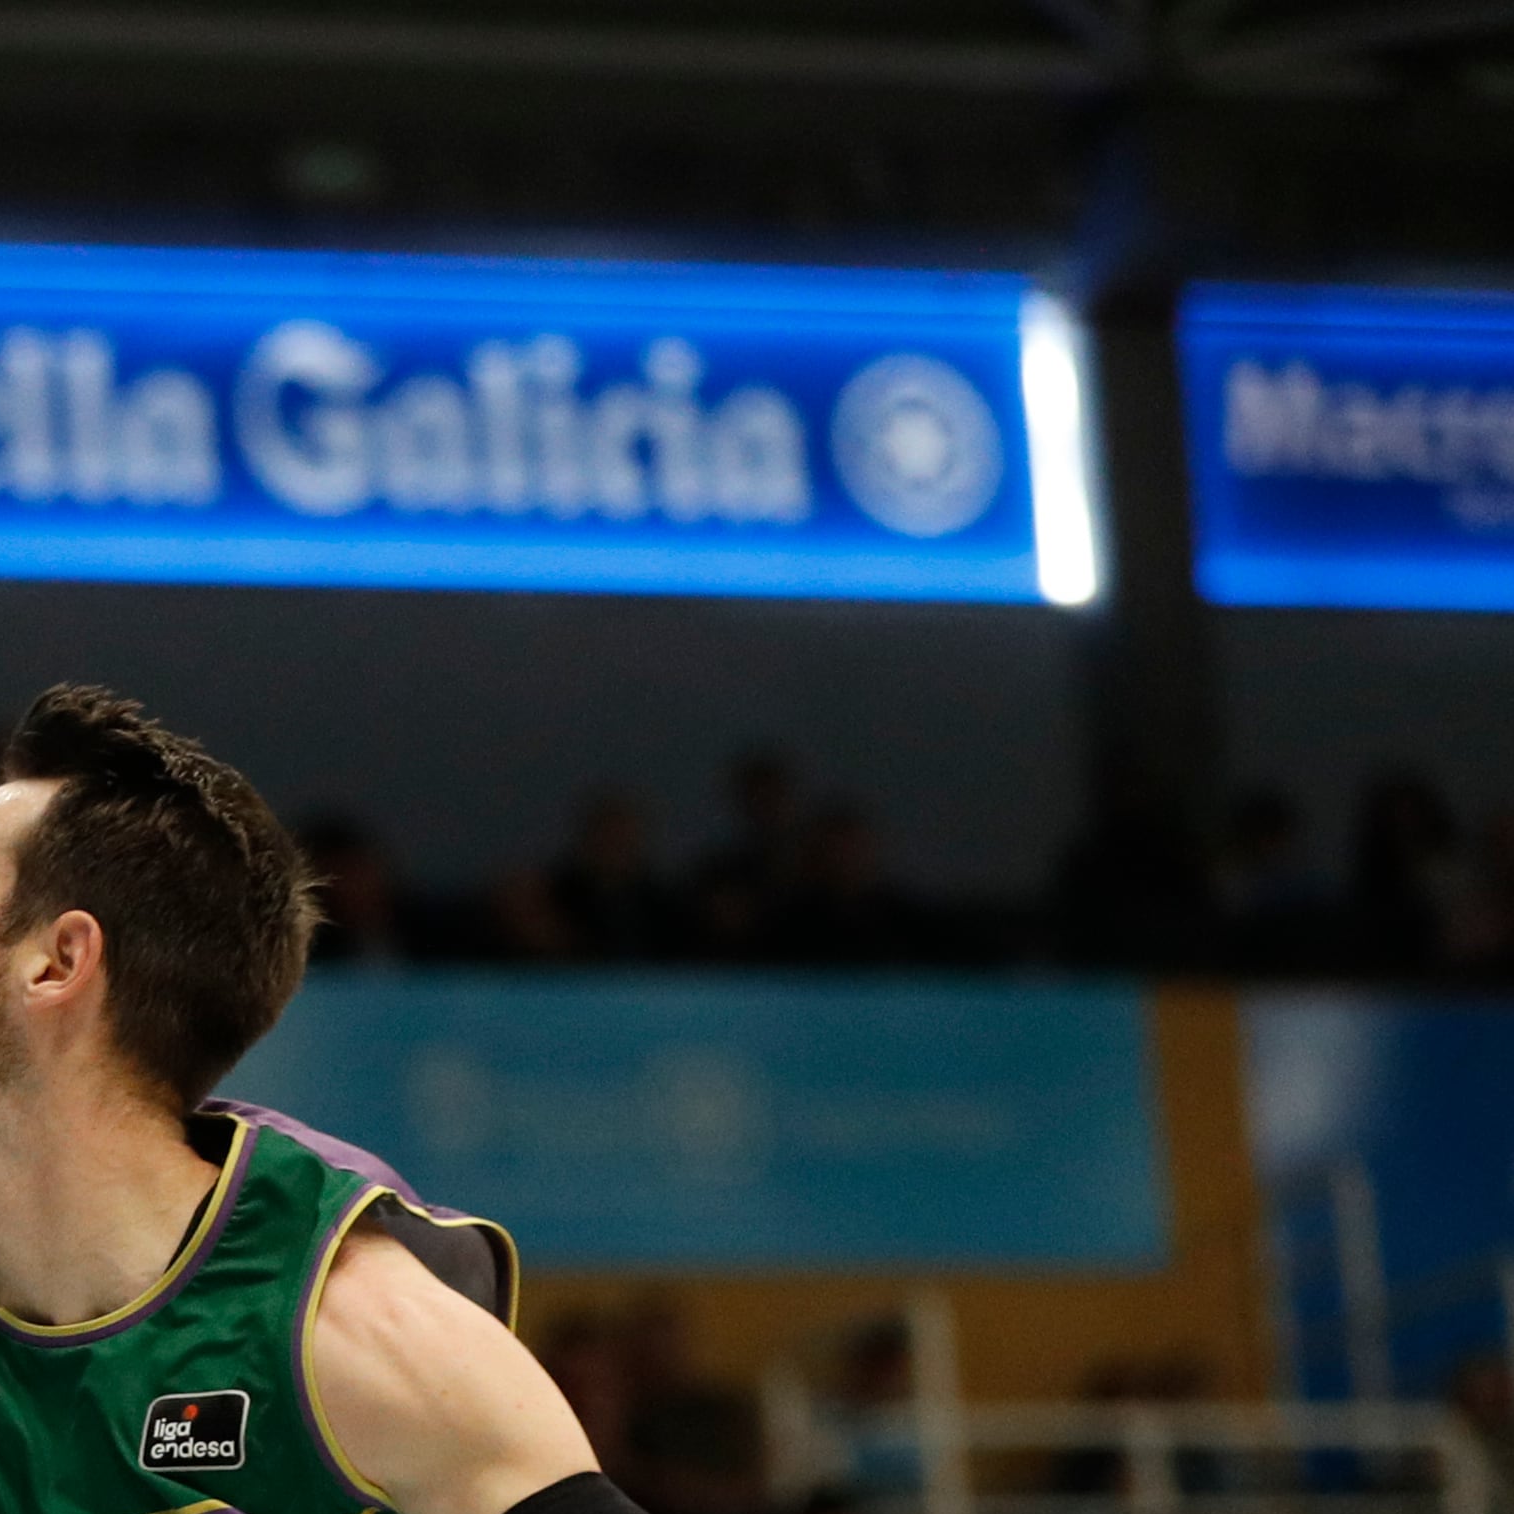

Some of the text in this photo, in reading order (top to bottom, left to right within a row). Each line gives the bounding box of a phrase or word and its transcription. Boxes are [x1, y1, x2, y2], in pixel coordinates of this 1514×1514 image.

[235, 315, 809, 525] Galicia
[153, 1417, 192, 1441] liga
[150, 1437, 236, 1459] endesa
